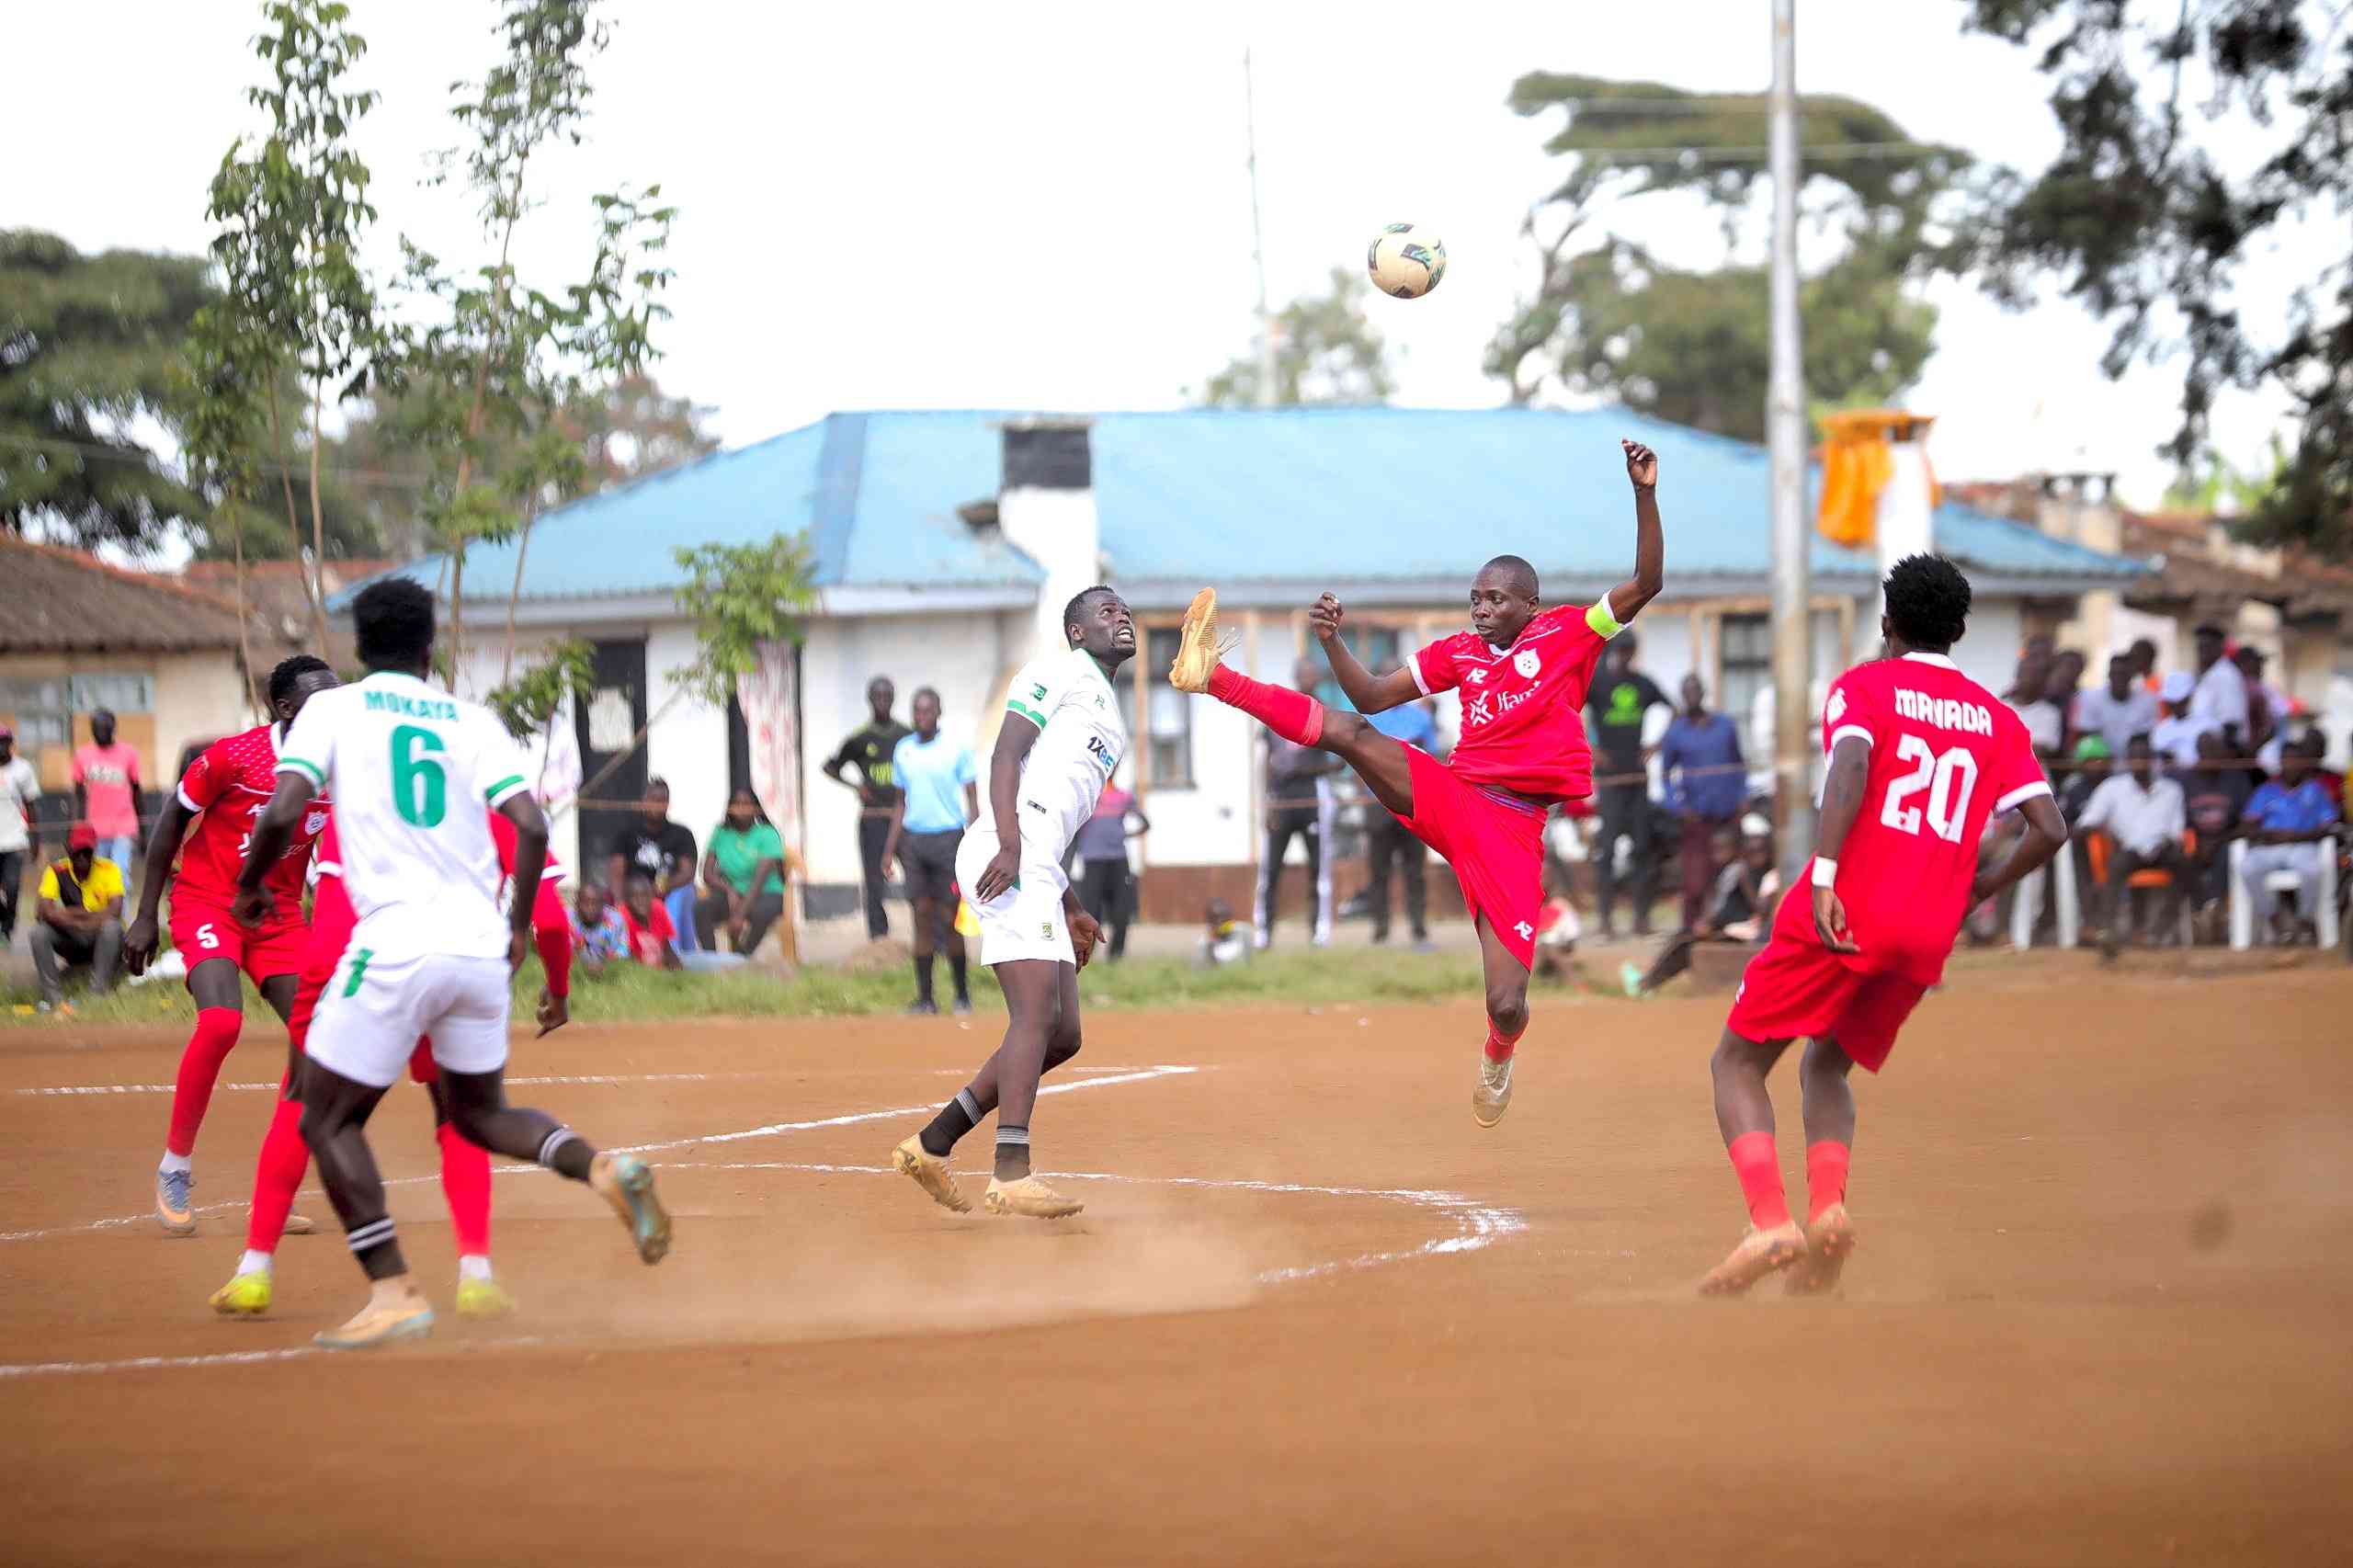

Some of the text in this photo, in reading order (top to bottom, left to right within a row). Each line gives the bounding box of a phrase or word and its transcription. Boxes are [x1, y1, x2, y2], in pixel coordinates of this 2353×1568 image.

[364, 690, 459, 722] MOKAYA
[391, 722, 447, 829] 6
[1881, 733, 1979, 845] 20
[196, 923, 220, 949] 5
